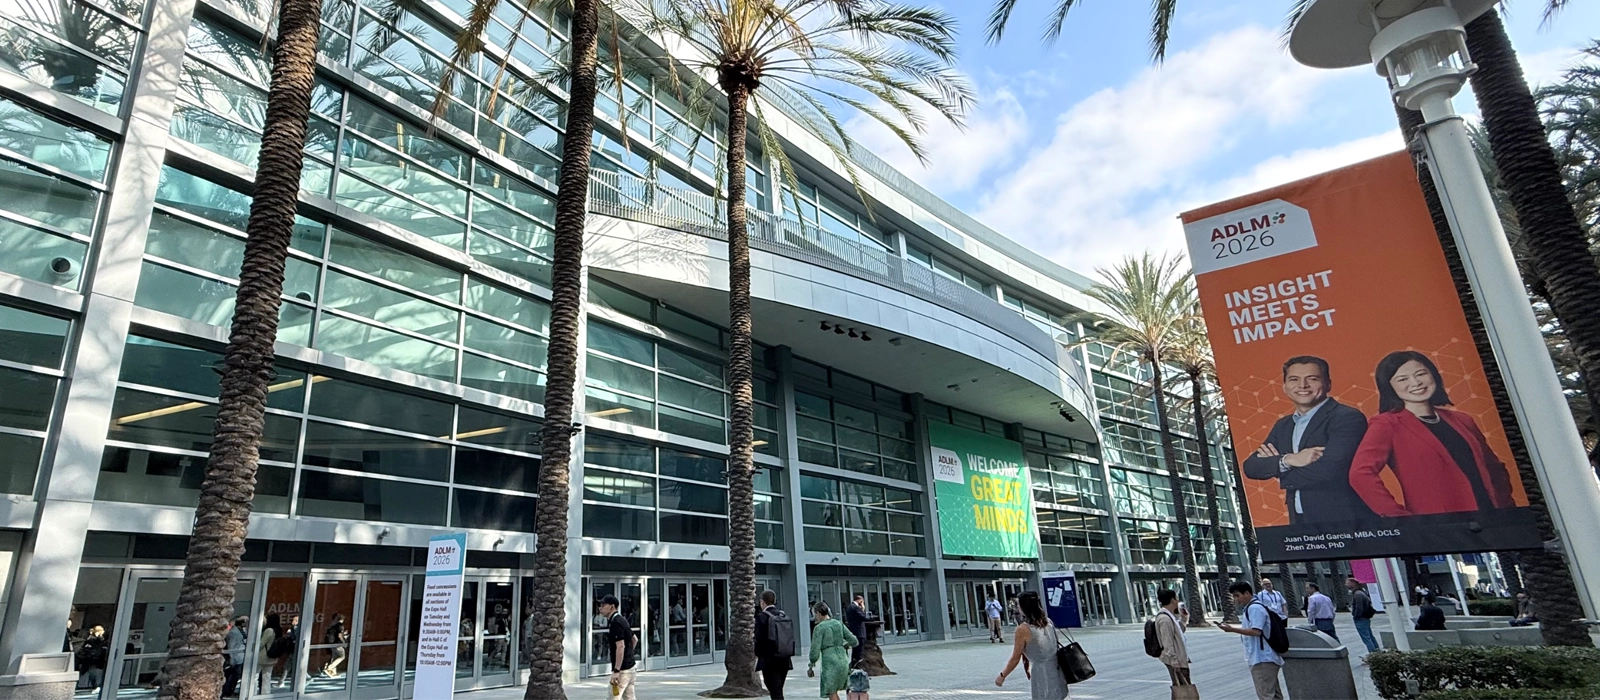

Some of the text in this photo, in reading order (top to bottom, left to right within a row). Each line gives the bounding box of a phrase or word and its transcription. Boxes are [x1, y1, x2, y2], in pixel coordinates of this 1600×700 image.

[1210, 214, 1271, 242] ADLM
[1212, 230, 1275, 260] 2026
[1224, 269, 1333, 309] INSIGHT
[1228, 294, 1320, 327] MEETS
[1233, 308, 1336, 345] IMPACT
[938, 455, 955, 466] ADLM
[939, 464, 956, 477] 2026
[966, 453, 1021, 479] WELCOME
[970, 474, 1022, 506] GREAT
[973, 503, 1028, 535] MINDS
[1303, 534, 1325, 542] David
[1326, 533, 1354, 541] Garcia,
[1354, 531, 1376, 539] MBA,
[1377, 529, 1400, 537] DCLS
[1328, 541, 1345, 549] PhD
[433, 555, 451, 566] 2026
[434, 546, 452, 554] ADLM
